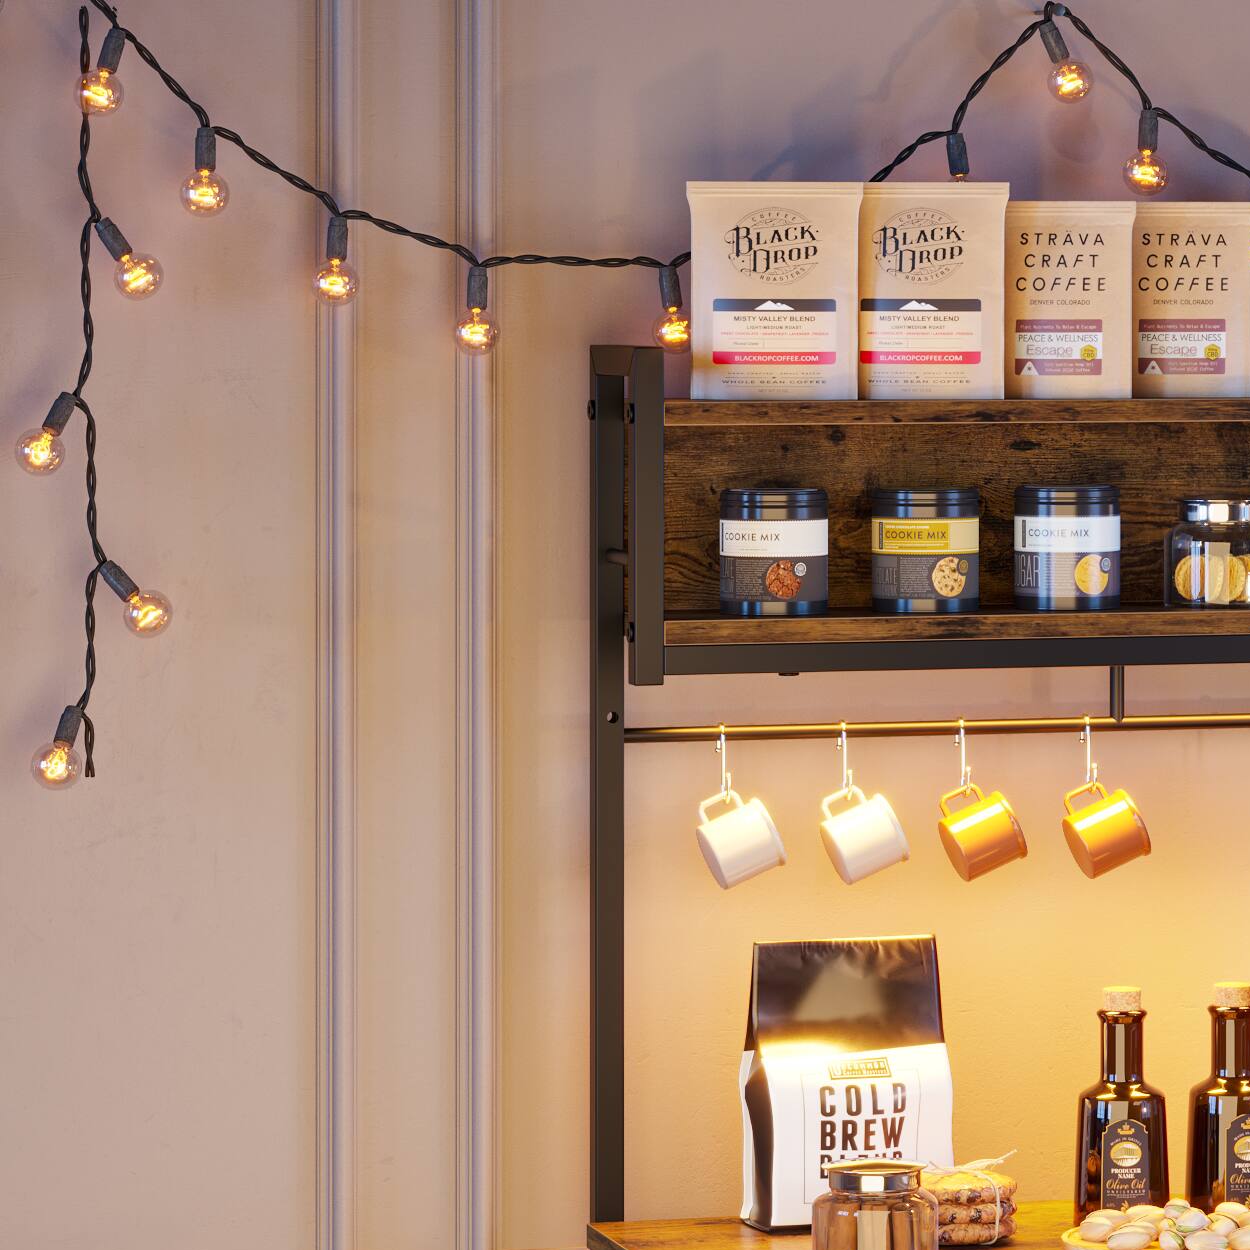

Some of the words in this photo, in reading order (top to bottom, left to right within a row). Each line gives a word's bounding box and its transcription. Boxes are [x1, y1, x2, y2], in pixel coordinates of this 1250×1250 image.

[725, 225, 817, 257] BLACK
[872, 225, 963, 257] BLACK
[747, 246, 818, 273] DROP
[894, 246, 963, 273] DROP
[1024, 254, 1098, 268] CRAFT
[1146, 254, 1222, 268] CRAFT
[1015, 277, 1106, 291] COFFEE
[1138, 277, 1229, 291] COFFEE
[1018, 334, 1046, 342] PEACE
[1055, 334, 1098, 342] WELLNESS
[1141, 334, 1170, 342] PEACE
[1180, 334, 1222, 342] WELLNESS
[1026, 344, 1073, 357] Escape
[1150, 344, 1198, 356] Escape
[725, 532, 757, 541] COOKIE
[760, 533, 781, 541] MIX
[885, 530, 923, 539] COOKIE
[927, 531, 946, 539] MIX
[1028, 529, 1067, 538] COOKIE
[1071, 529, 1089, 537] MIX
[819, 1082, 906, 1117] COLD
[820, 1116, 905, 1151] BREW
[1105, 1178, 1130, 1190] Olive
[1131, 1178, 1146, 1190] Oil
